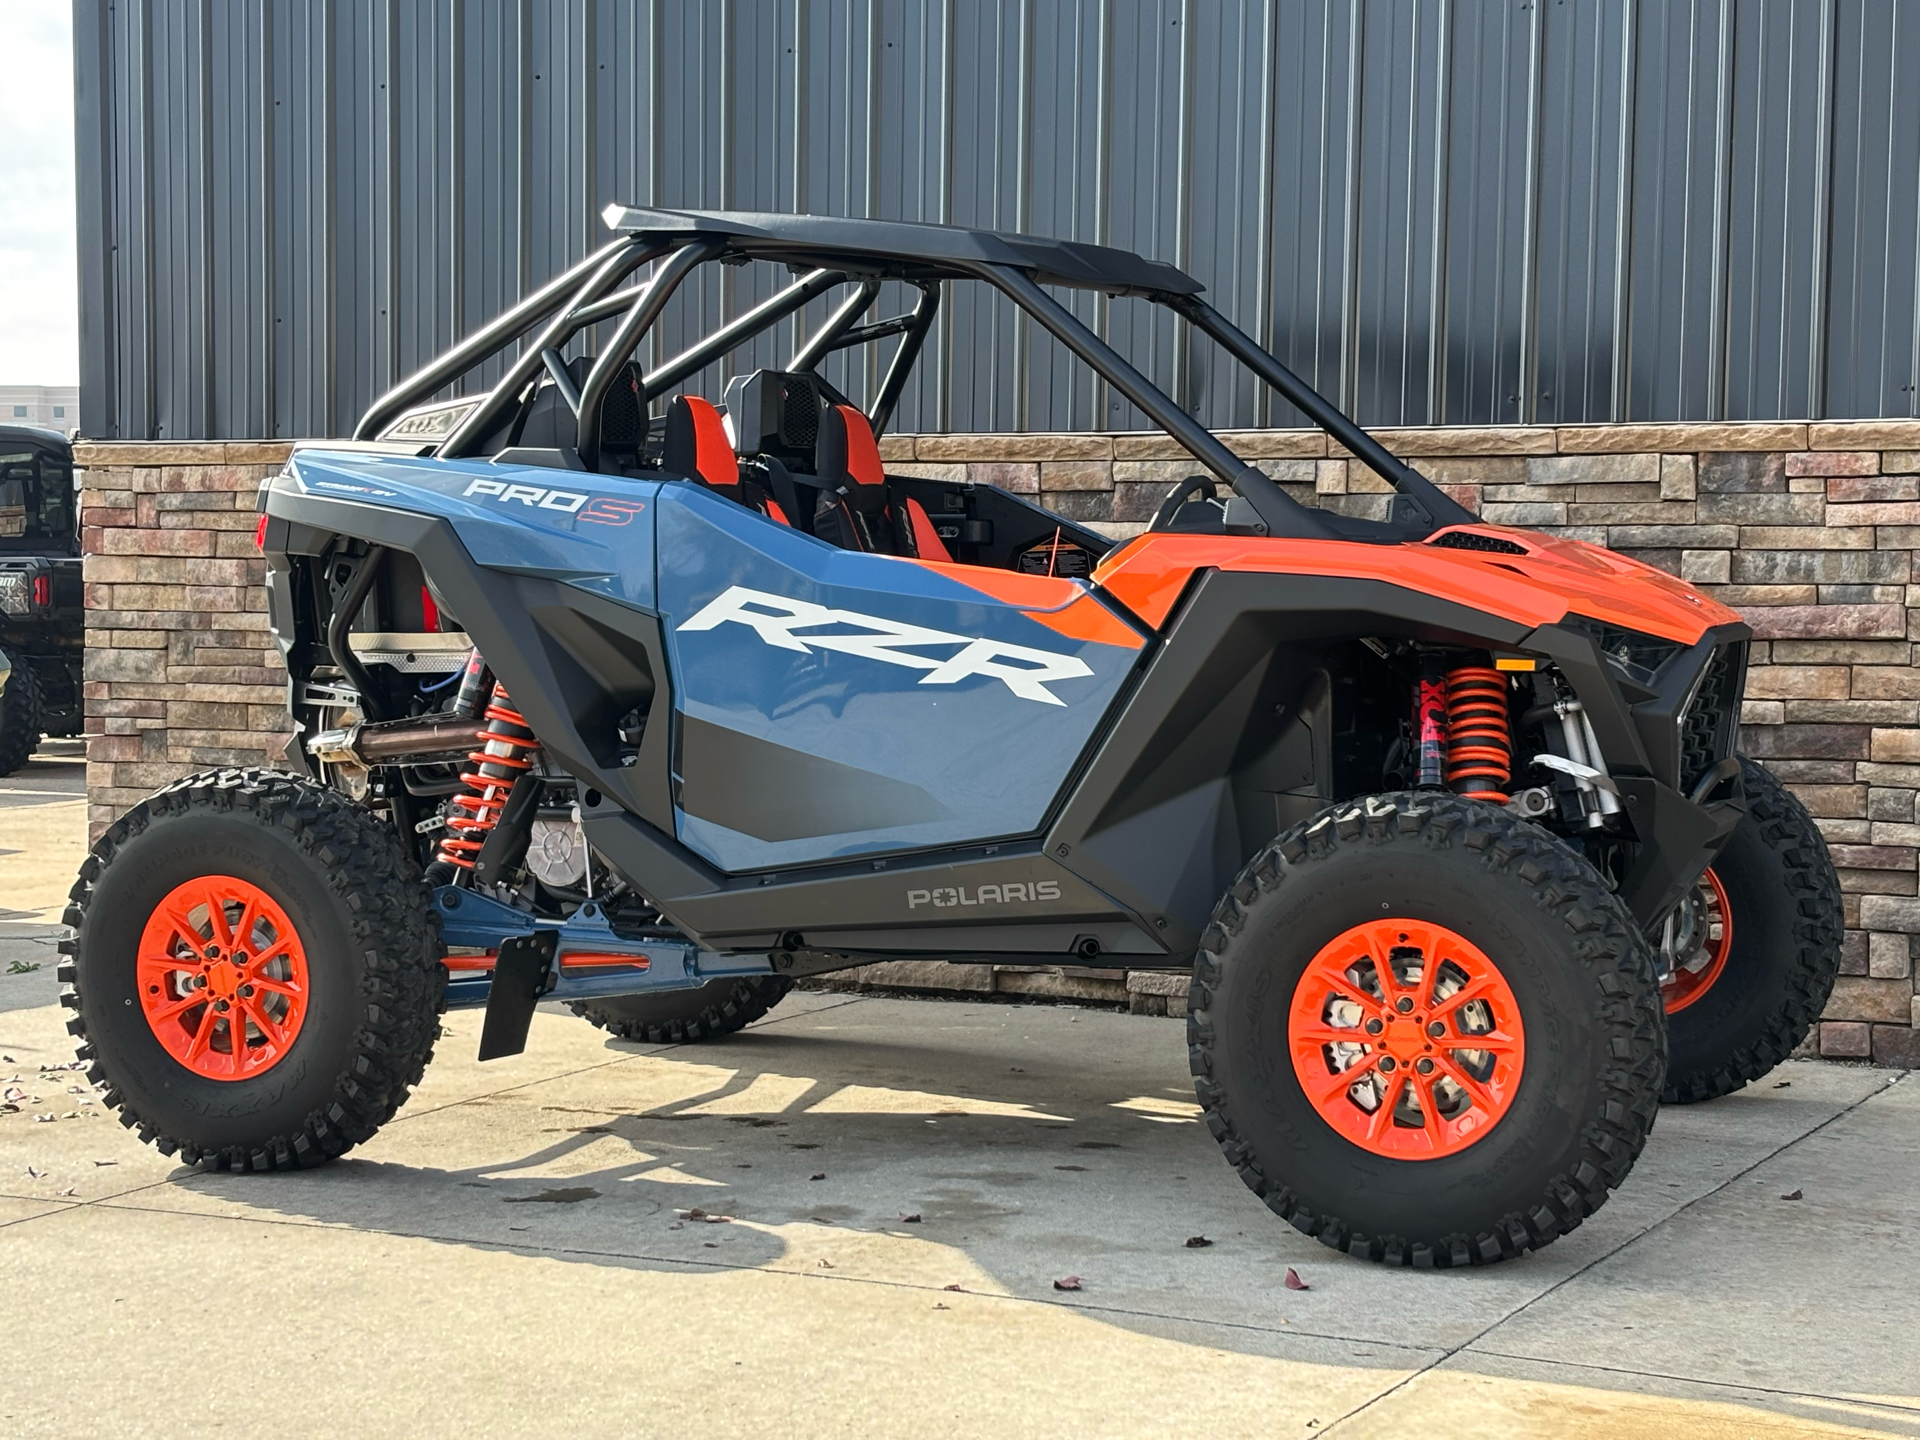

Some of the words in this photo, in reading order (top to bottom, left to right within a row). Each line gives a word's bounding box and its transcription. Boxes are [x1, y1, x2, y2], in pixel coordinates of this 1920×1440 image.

[462, 478, 589, 514] PRO
[576, 497, 646, 527] S
[675, 585, 1096, 707] RZR
[906, 880, 1062, 909] POLARIS
